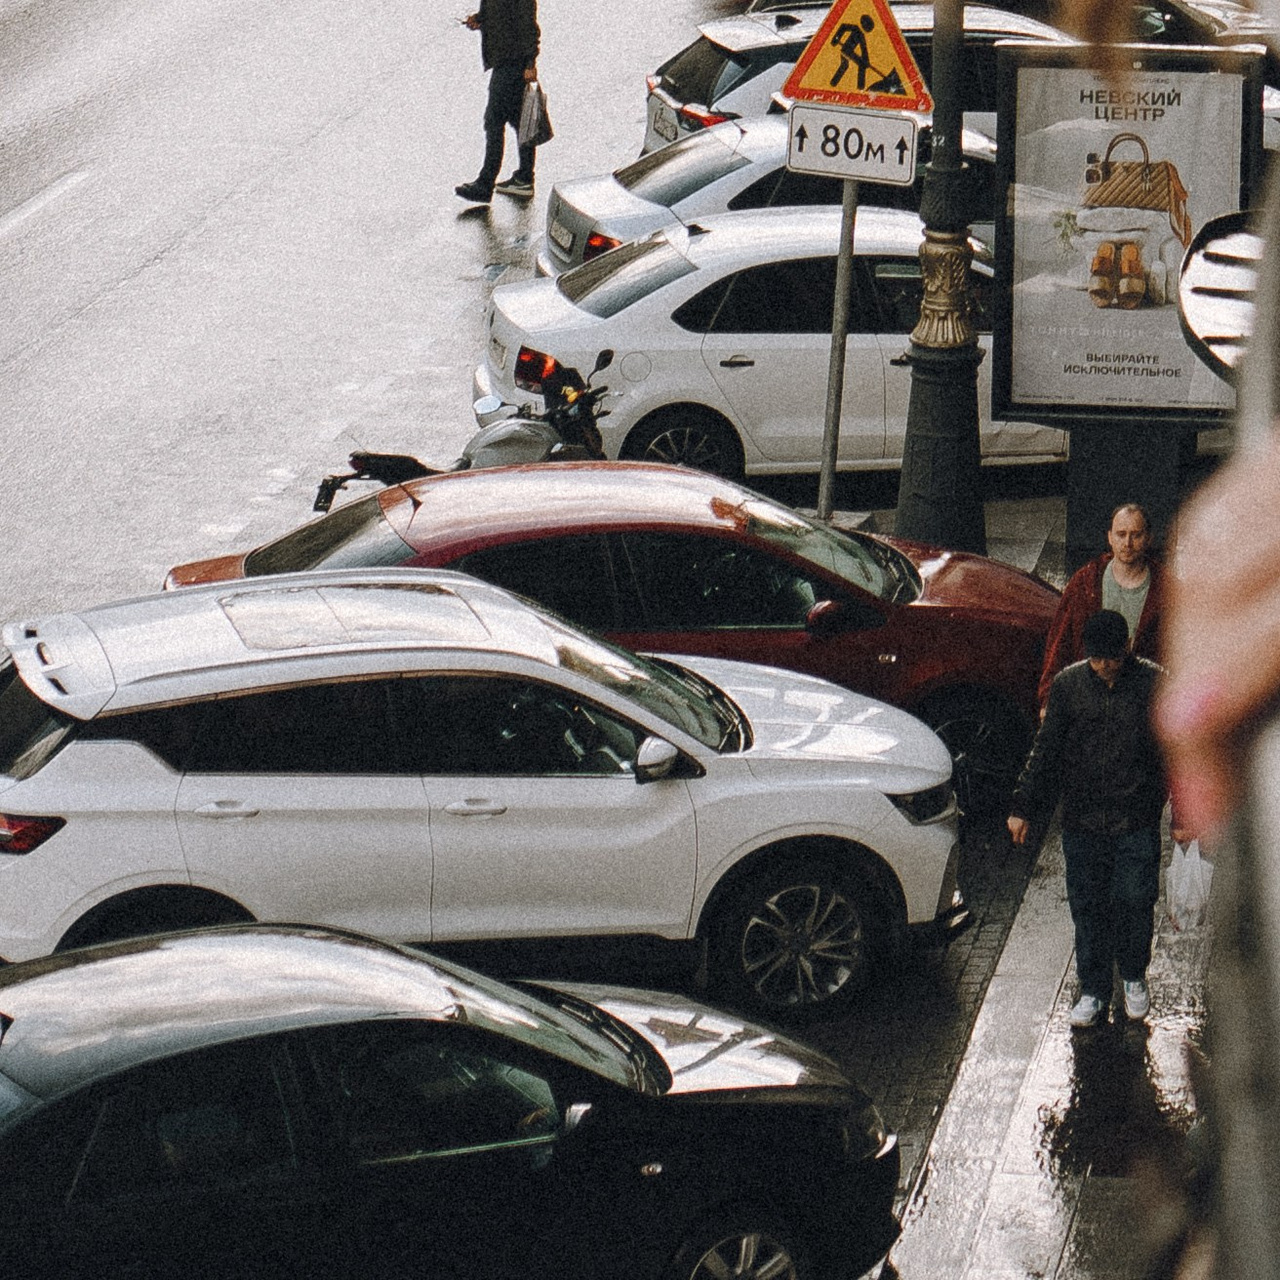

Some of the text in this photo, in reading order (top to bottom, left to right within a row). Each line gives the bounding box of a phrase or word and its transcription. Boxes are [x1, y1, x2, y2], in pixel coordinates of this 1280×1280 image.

[1079, 88, 1181, 106] НЕВСКИЙ
[1094, 106, 1166, 122] ЦЕНТР
[1086, 352, 1160, 365] ВЫБИРАЙТЕ
[1063, 364, 1182, 378] ИСКЛЮЧИТЕЛЬНОЕ
